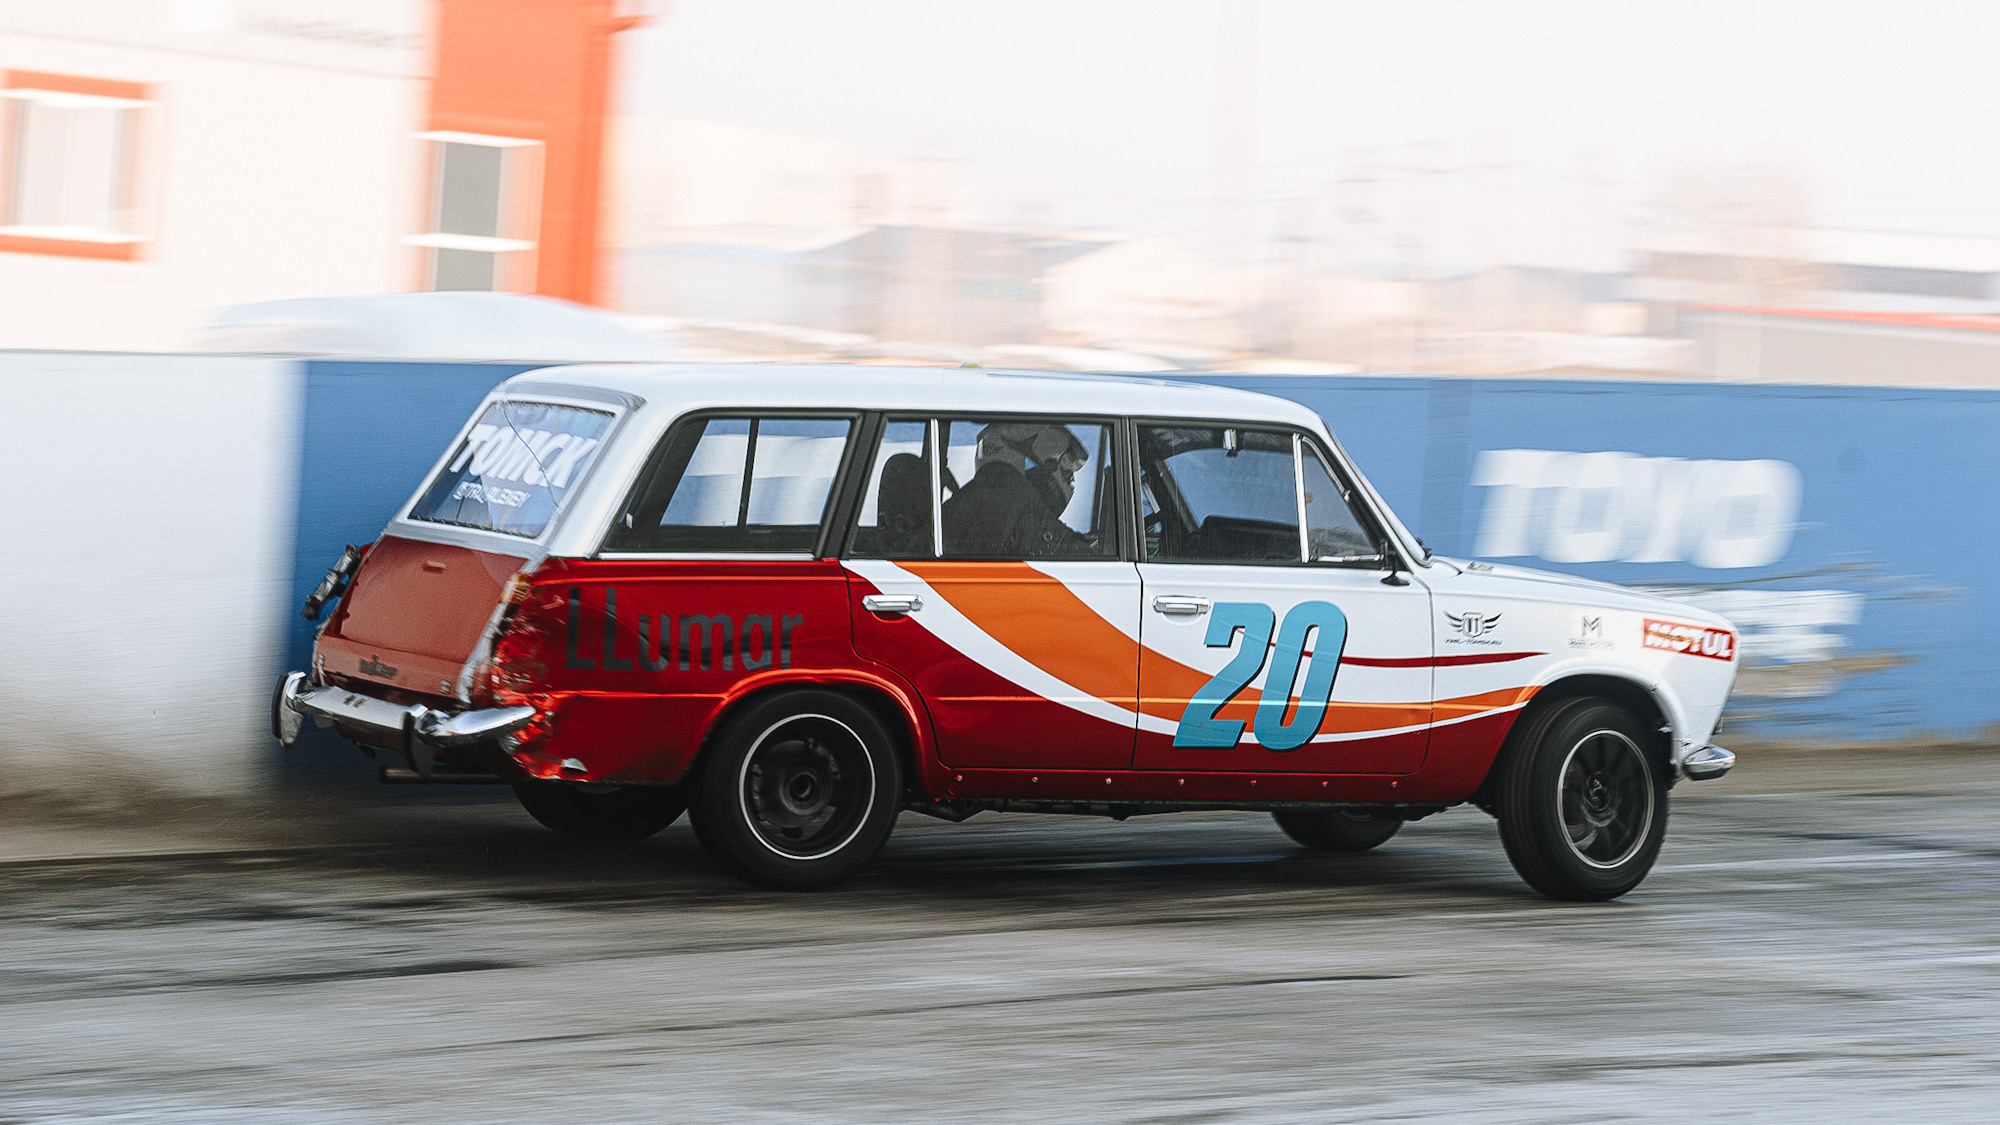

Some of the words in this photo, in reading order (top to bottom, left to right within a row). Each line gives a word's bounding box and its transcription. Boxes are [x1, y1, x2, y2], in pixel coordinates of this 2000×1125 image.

[565, 587, 804, 671] LLumar
[1644, 622, 1733, 657] MOTUL
[1173, 601, 1348, 753] 20
